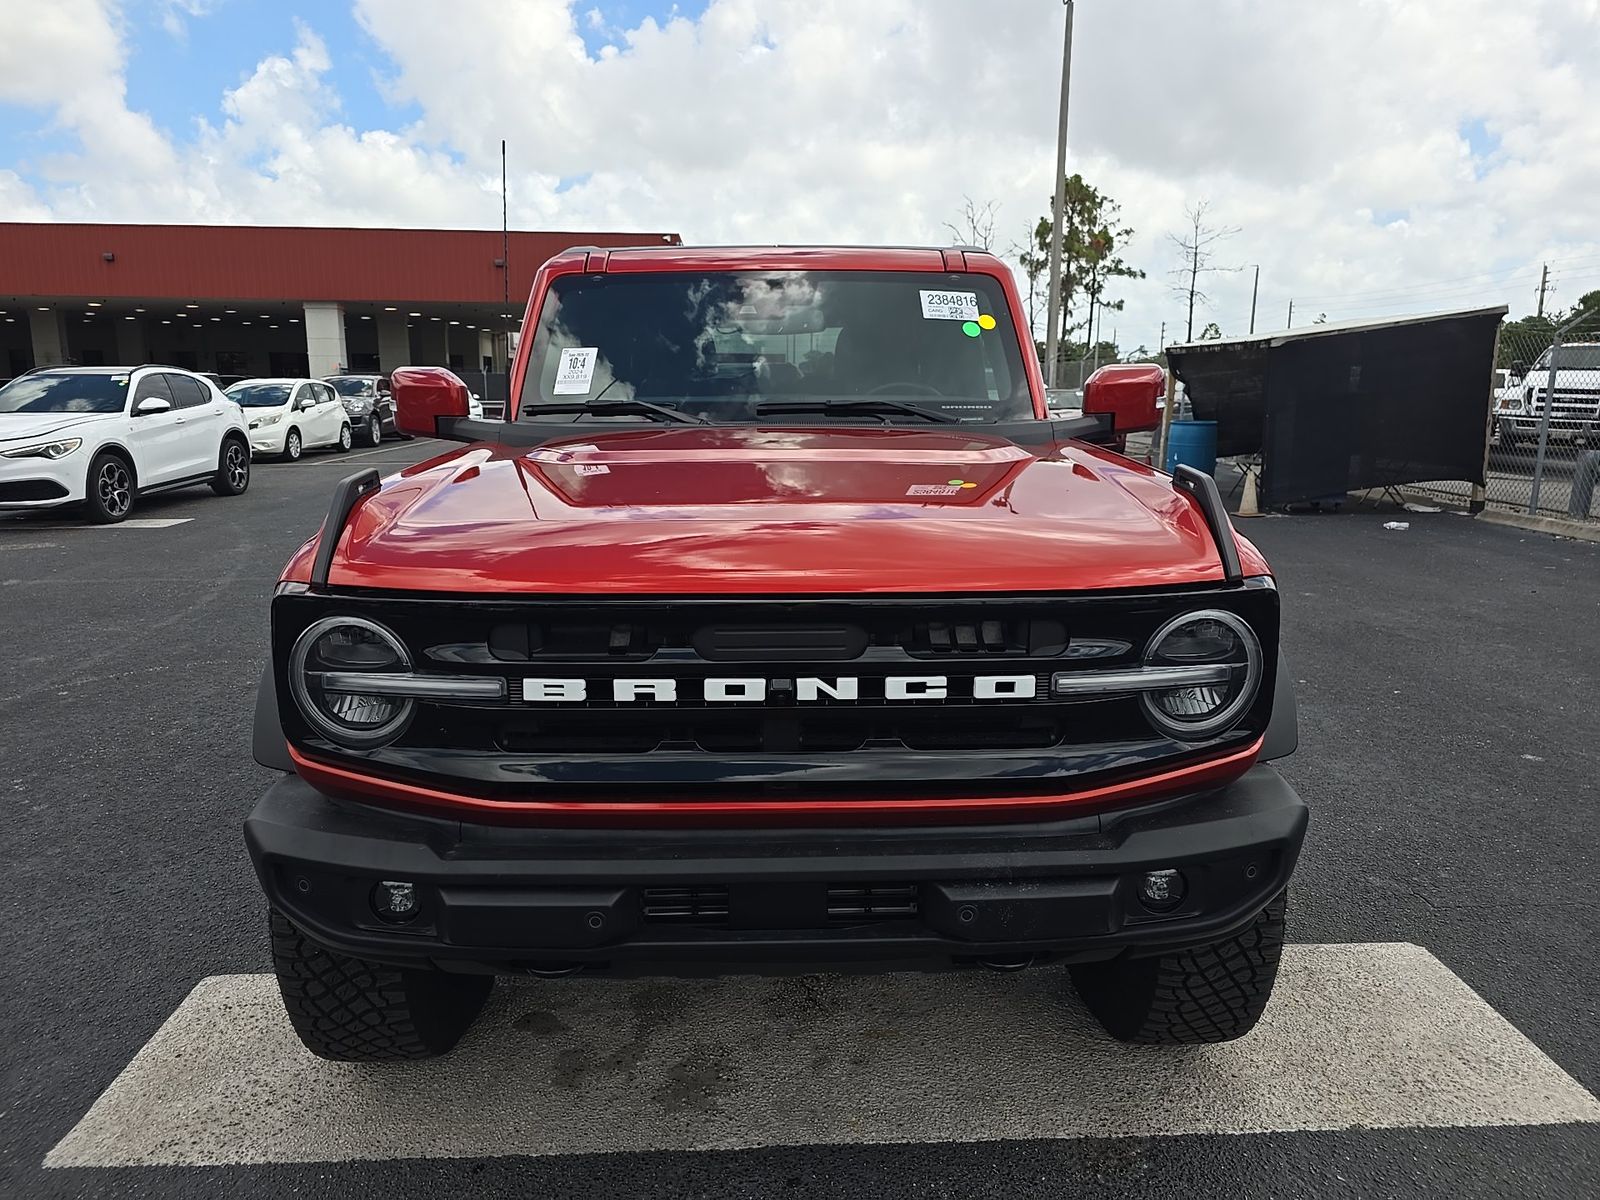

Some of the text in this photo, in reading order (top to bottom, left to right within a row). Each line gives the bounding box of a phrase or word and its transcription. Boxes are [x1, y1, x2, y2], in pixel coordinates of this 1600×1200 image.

[927, 294, 978, 307] 2384816
[568, 357, 586, 369] 10:4
[523, 675, 1036, 701] BRONCO
